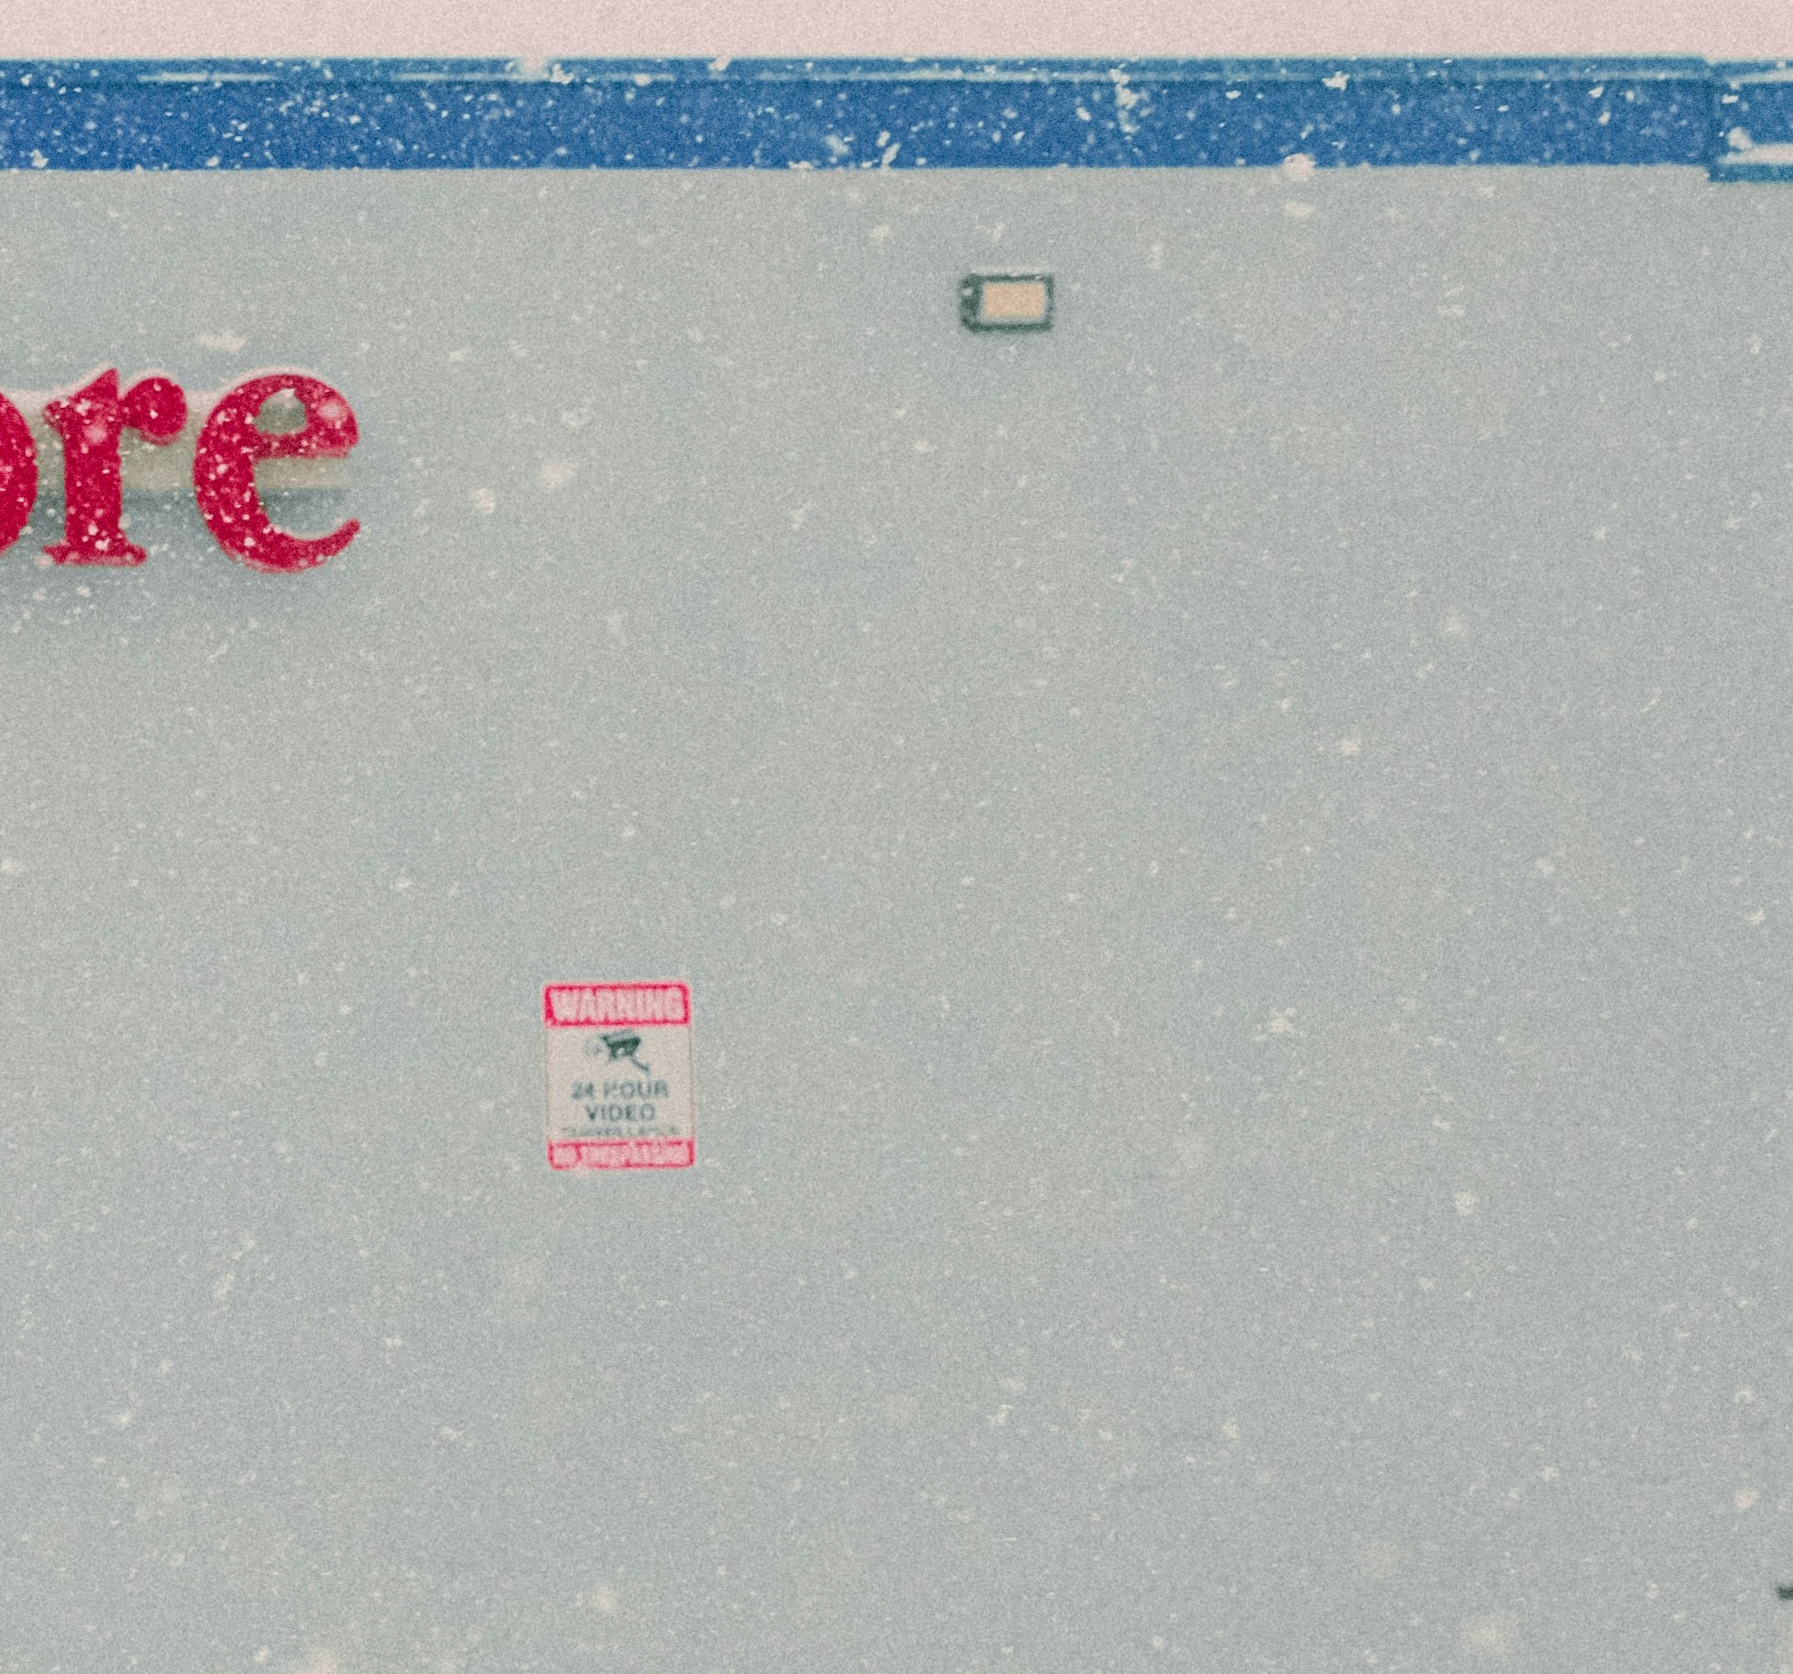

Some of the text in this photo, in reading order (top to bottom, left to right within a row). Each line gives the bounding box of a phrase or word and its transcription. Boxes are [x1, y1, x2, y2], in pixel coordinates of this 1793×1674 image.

[550, 988, 684, 1022] WARNING
[572, 1079, 669, 1099] 24 HOUR
[585, 1104, 656, 1121] VIDEO
